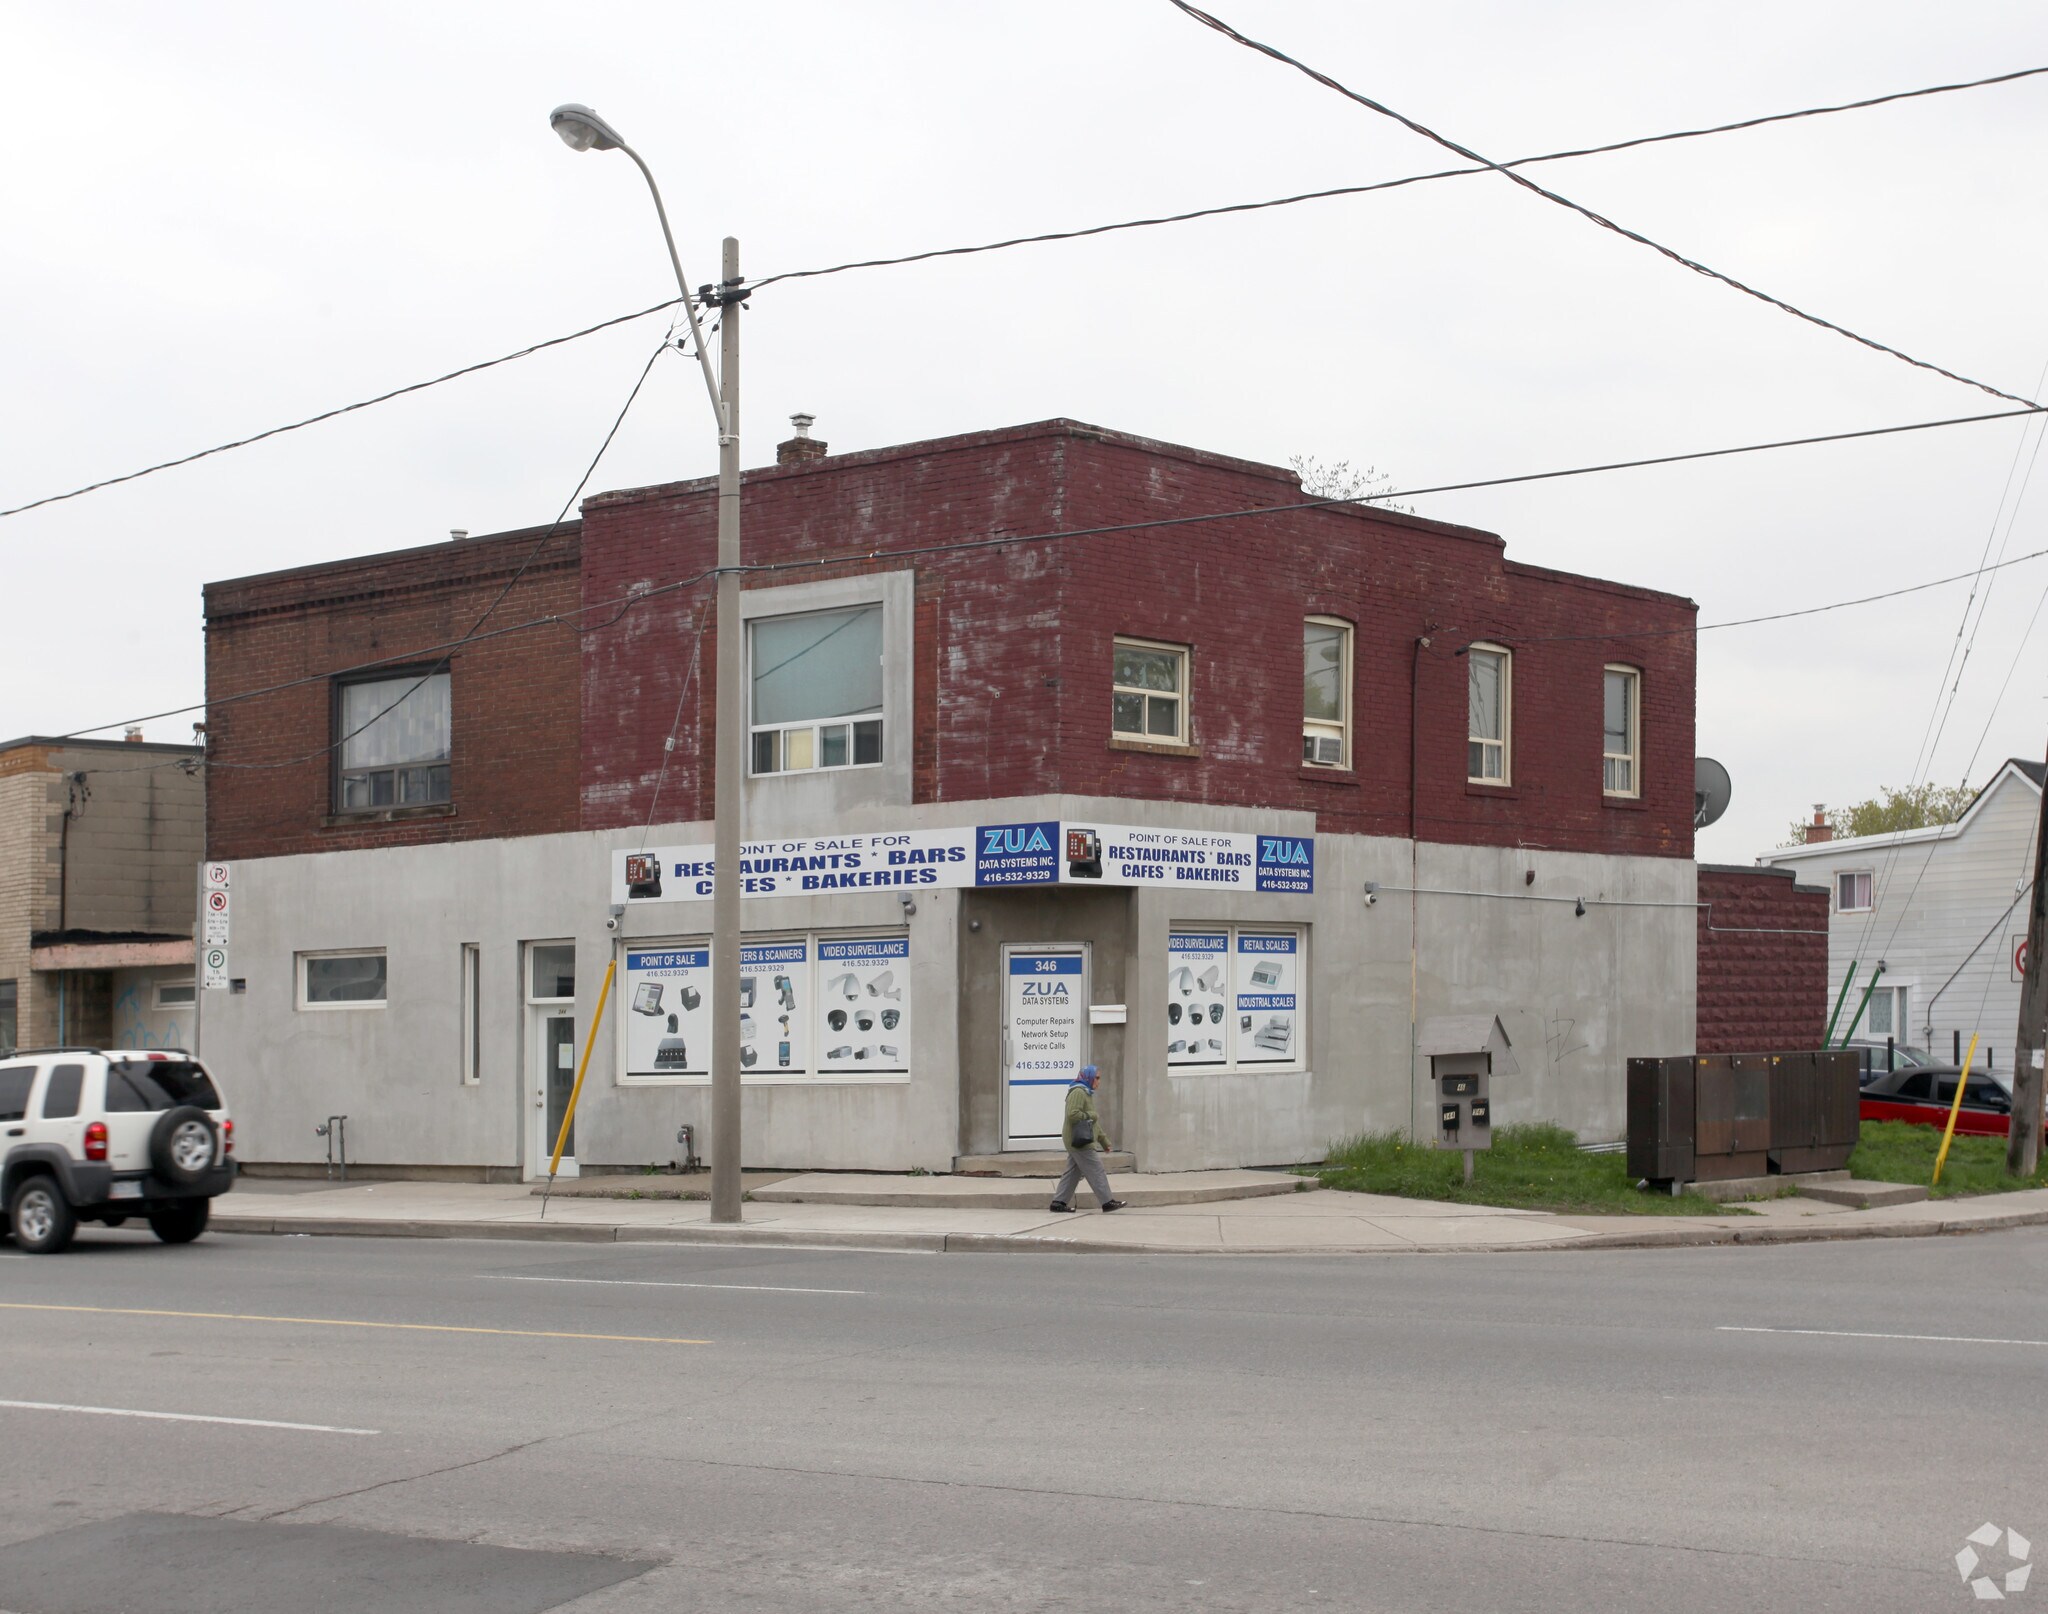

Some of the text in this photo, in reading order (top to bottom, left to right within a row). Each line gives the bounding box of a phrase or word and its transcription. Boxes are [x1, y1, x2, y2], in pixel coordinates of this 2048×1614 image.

[740, 835, 911, 855] INT OF SALE FOR
[983, 826, 1052, 855] ZUA
[1129, 833, 1232, 848] POINT OF SALE FOR
[1108, 845, 1252, 867] RESTAURANTS BARS
[1261, 839, 1309, 864] ZUA
[674, 846, 966, 877] RESAURANTS BARS
[978, 856, 1056, 870] DATA SYSTEMS INC.
[983, 870, 1051, 882] 416-532-9329
[1121, 863, 1240, 883] CAFES BAKERIES
[1258, 867, 1312, 879] DATA SYSTEMS INC.
[695, 868, 938, 895] CES BAKERIES
[1262, 880, 1309, 890] 416-532-9329
[823, 943, 904, 957] VIDEO SURVEILLANCE
[1184, 938, 1225, 950] SURVEILLANCE
[1243, 939, 1290, 951] RETAIL SCALES
[641, 954, 696, 967] POINT OF SALE
[758, 950, 764, 961] &
[764, 949, 803, 960] SCANNERS
[740, 964, 785, 973] 416.532.9329
[842, 959, 889, 967] 416.532.9329
[1035, 960, 1057, 972] 346
[646, 969, 689, 977] 416.532.9329
[1022, 981, 1069, 996] ZUA
[1022, 996, 1069, 1005] DATA SYSTEMS
[1238, 997, 1294, 1008] INDUSTRIAL SCALES
[1016, 1016, 1075, 1026] Computer Repairs
[1021, 1029, 1069, 1039] Network Setup
[1023, 1041, 1066, 1050] Service Calls
[1015, 1060, 1075, 1070] 416.532.9329
